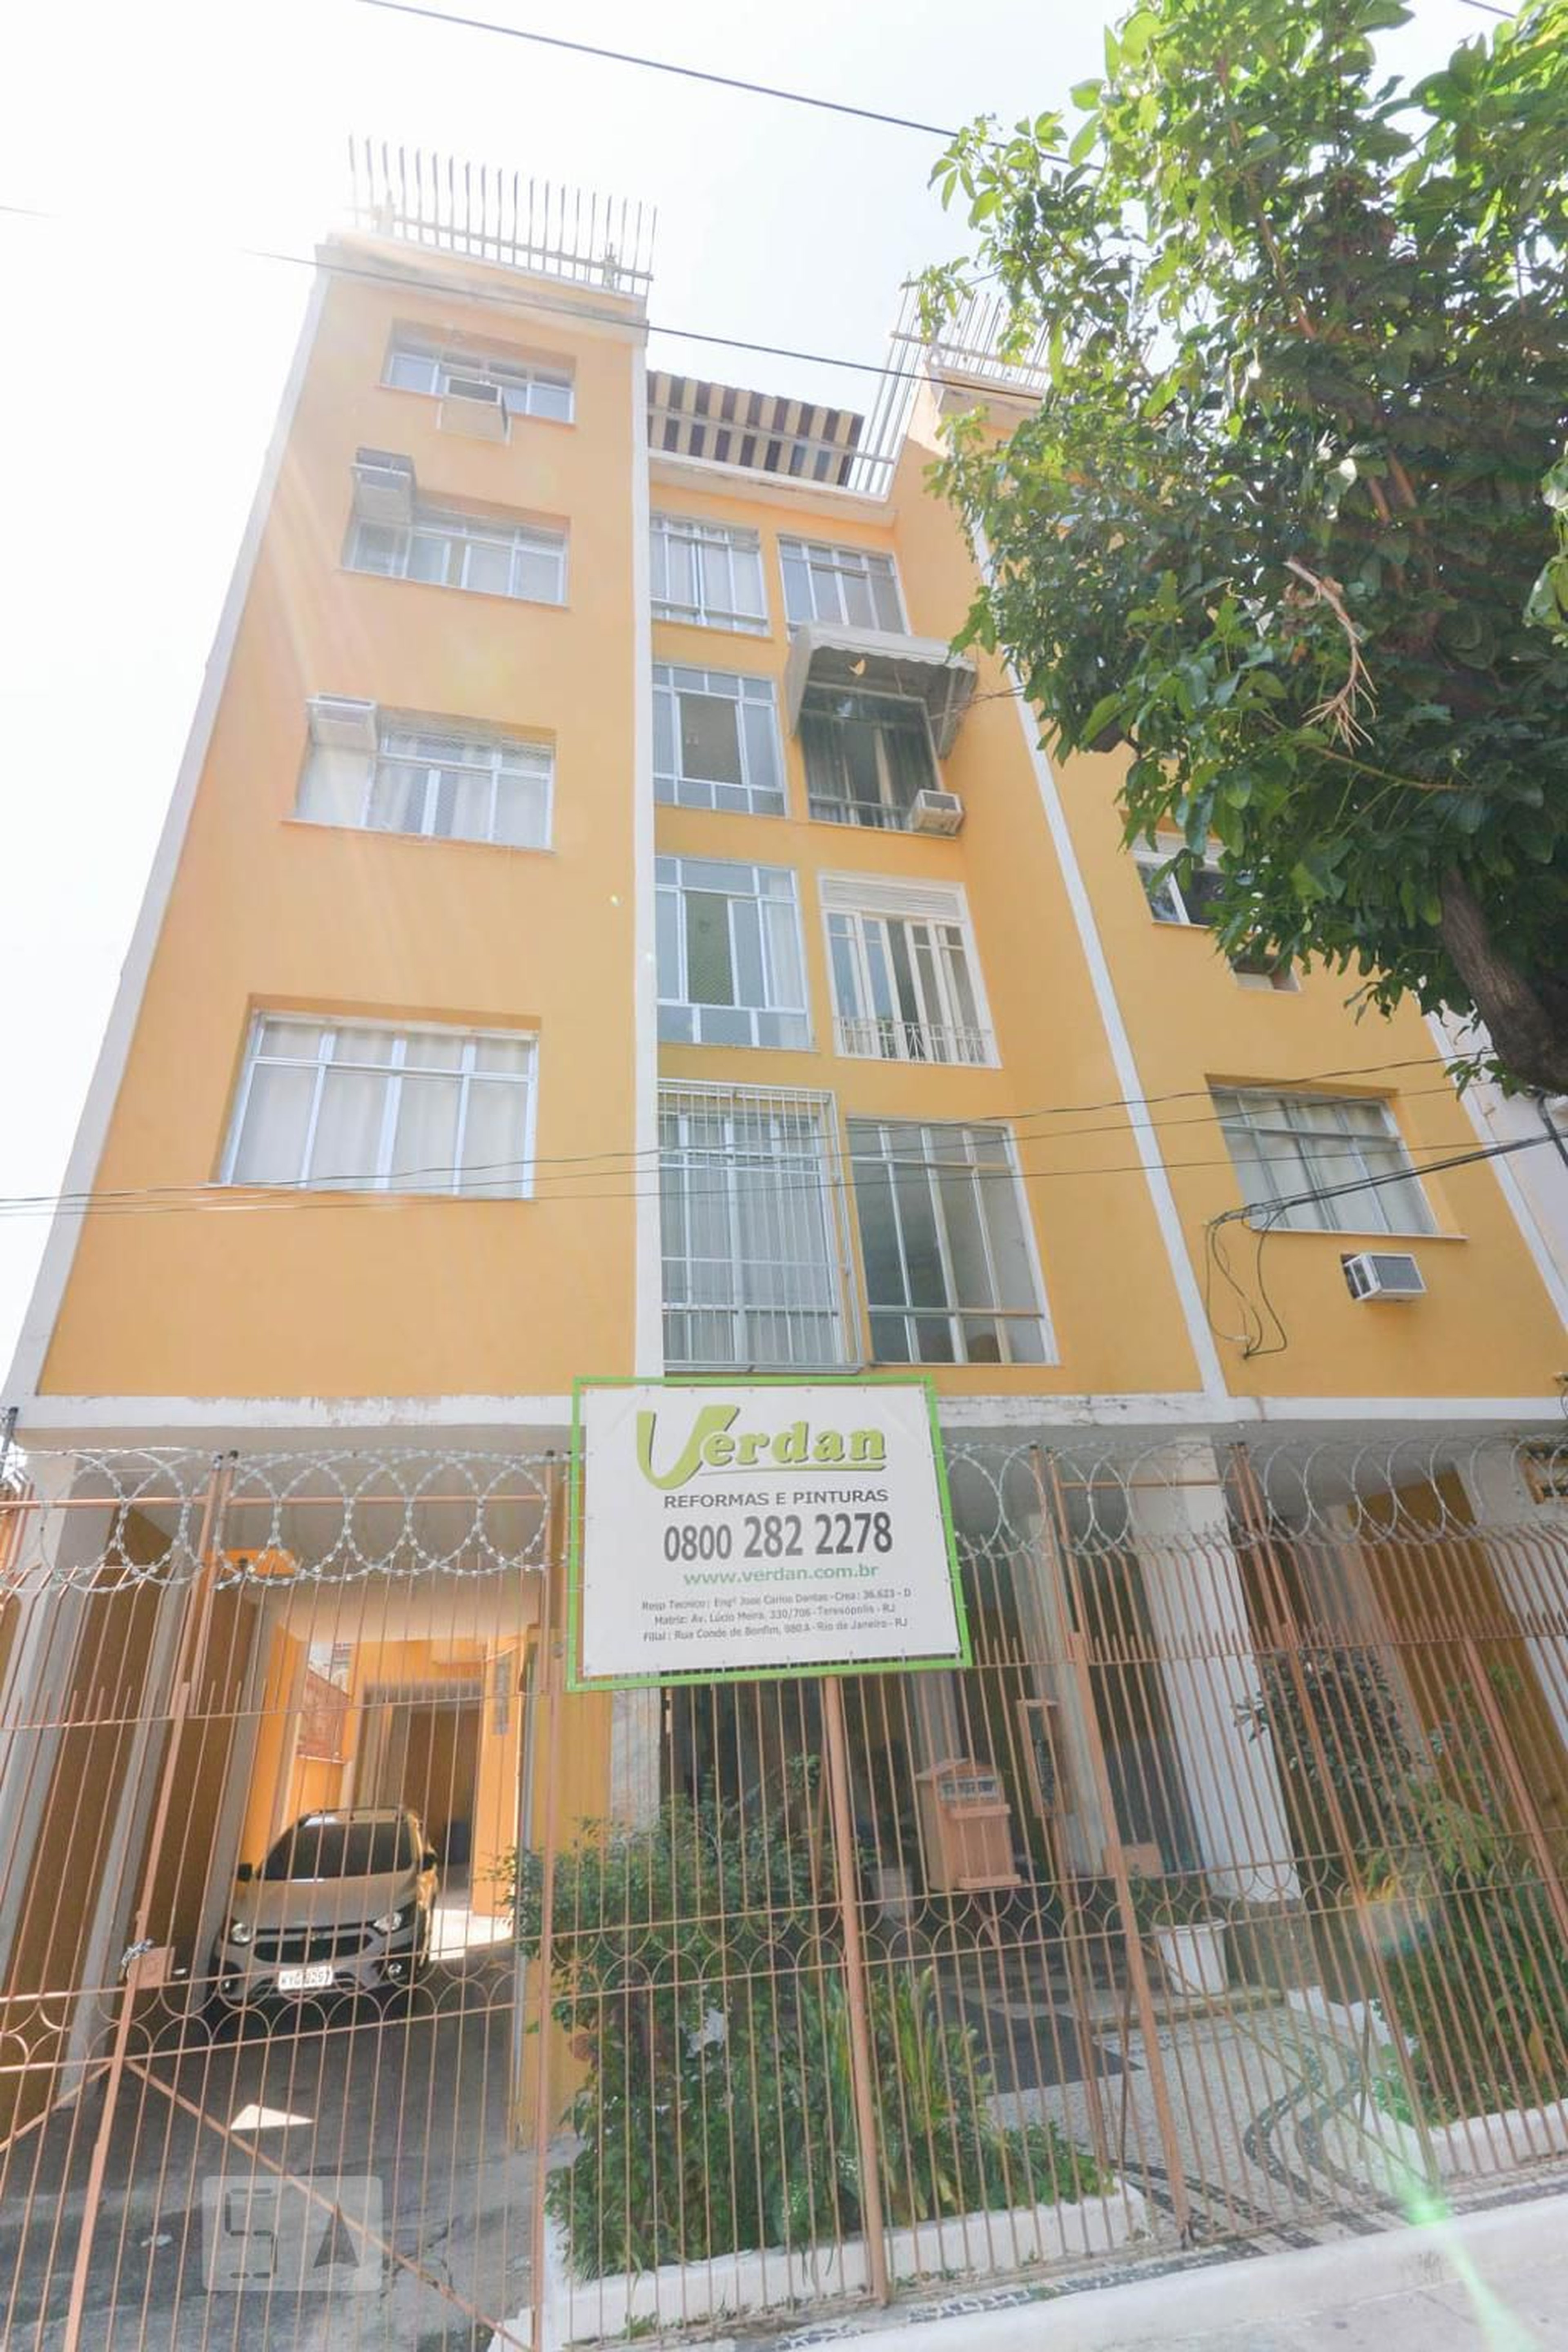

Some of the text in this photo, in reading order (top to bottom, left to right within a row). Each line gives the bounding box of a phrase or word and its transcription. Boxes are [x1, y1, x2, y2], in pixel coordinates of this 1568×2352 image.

[637, 1404, 886, 1490] Verdan
[664, 1490, 888, 1508] REFORMAS E PINTURAS
[664, 1512, 893, 1561] 0800 282 2278
[684, 1564, 879, 1586] www.verdan.com.br
[904, 1588, 911, 1597] D
[882, 1603, 895, 1613] RJ
[675, 1630, 693, 1639] Rua
[696, 1628, 726, 1638] Conde
[730, 1628, 742, 1637] de
[817, 1621, 833, 1631] Rio
[837, 1621, 848, 1630] de
[851, 1619, 887, 1629] Janeiro
[895, 1617, 907, 1627] RJ
